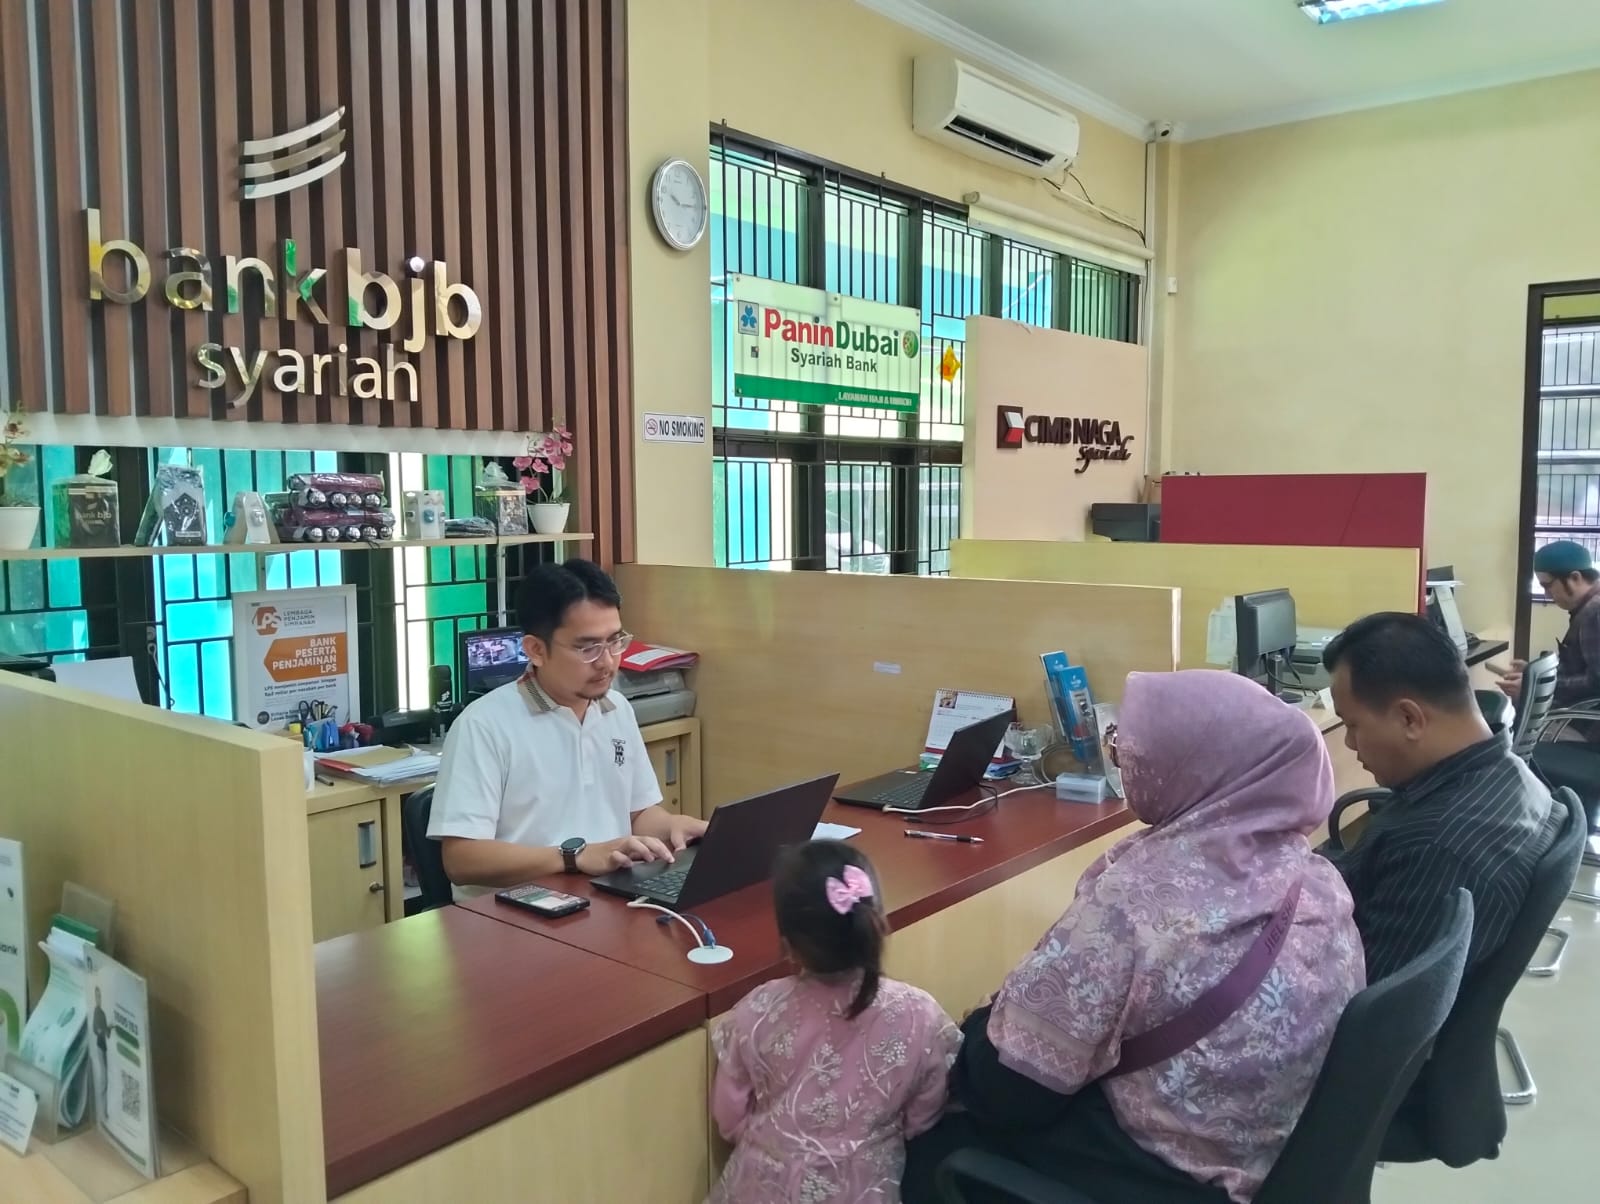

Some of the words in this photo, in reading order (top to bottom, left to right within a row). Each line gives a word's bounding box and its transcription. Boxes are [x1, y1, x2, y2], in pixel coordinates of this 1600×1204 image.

[83, 207, 330, 325] bank
[342, 247, 482, 353] bjb
[791, 347, 842, 369] Syariah
[846, 355, 878, 373] Bank
[194, 342, 418, 409] syariah
[659, 419, 670, 436] NO
[671, 420, 704, 438] SMOKING
[1024, 414, 1072, 444] CIMB
[1073, 417, 1122, 446] NIAGA
[310, 636, 337, 648] BANK
[295, 646, 337, 659] PESERTA
[272, 655, 337, 671] PENJAMINAN
[320, 663, 337, 674] LPS
[0, 942, 18, 957] ank
